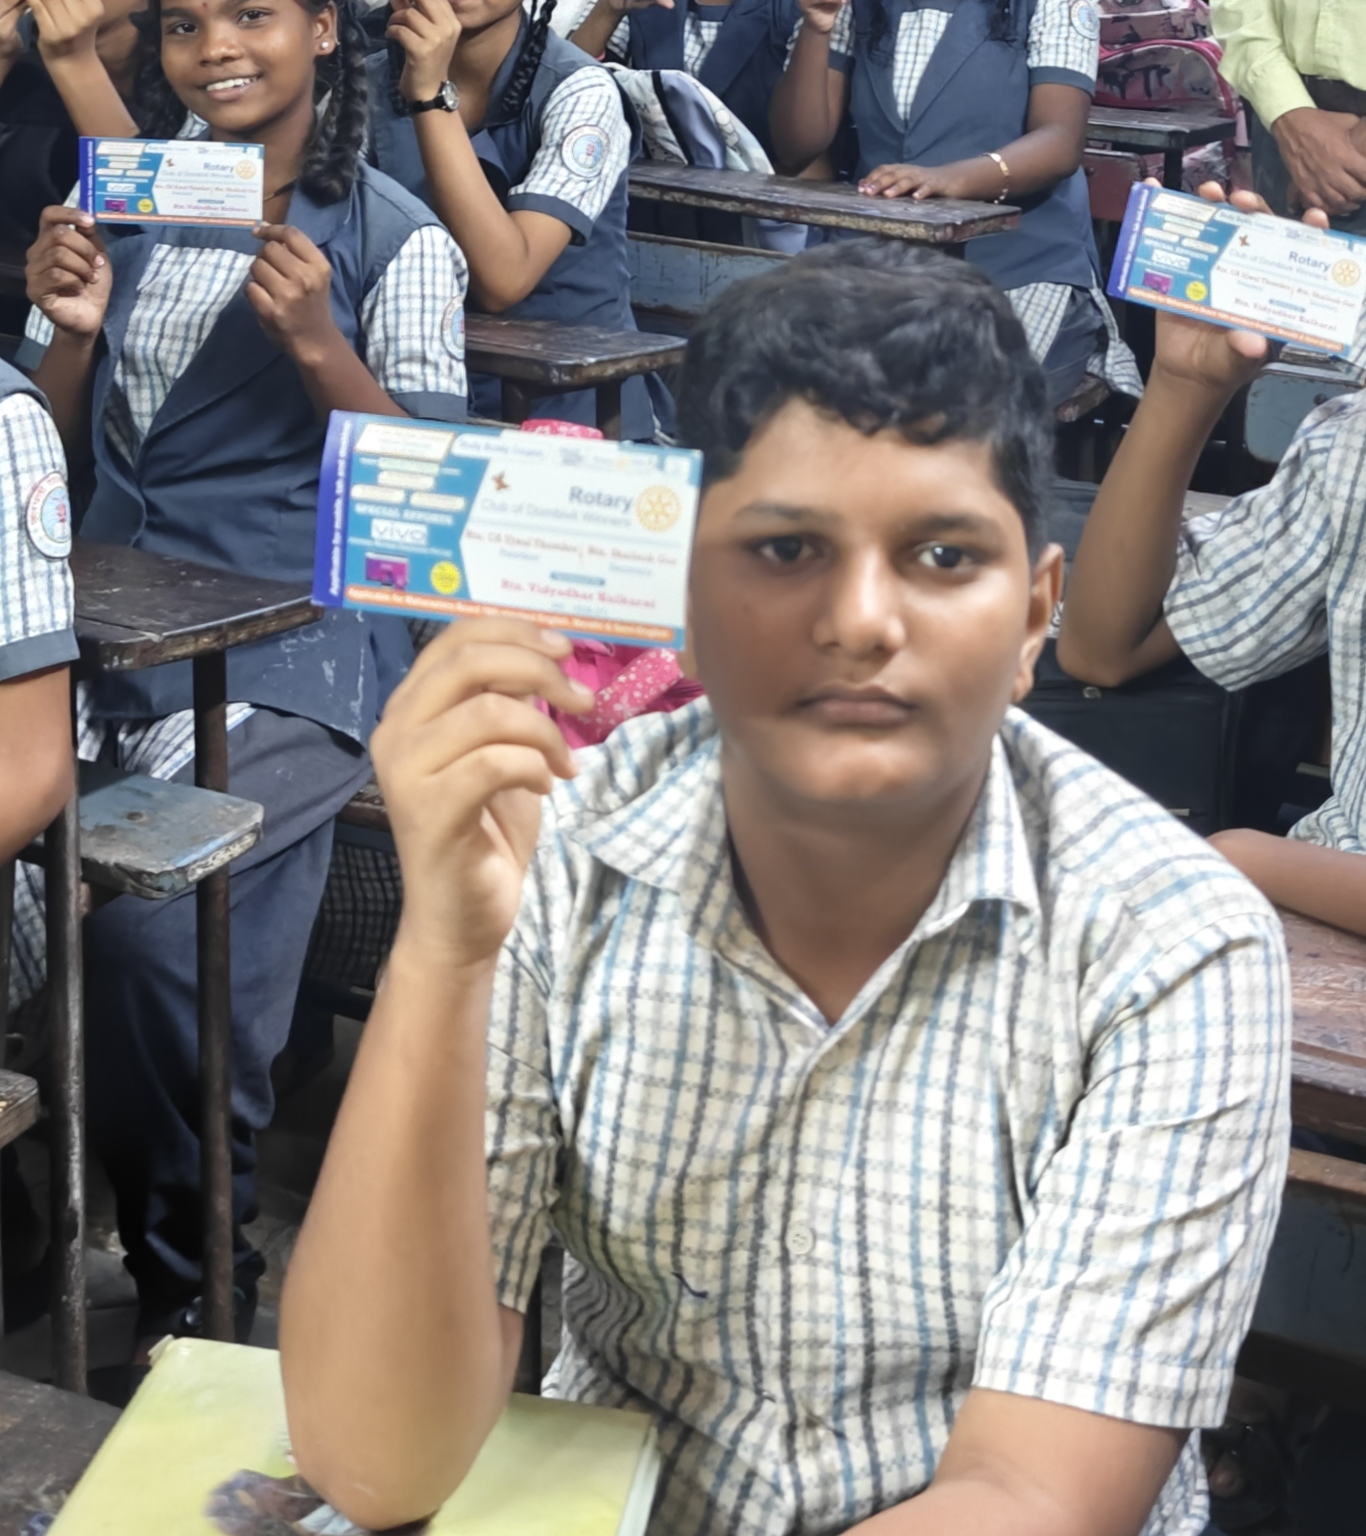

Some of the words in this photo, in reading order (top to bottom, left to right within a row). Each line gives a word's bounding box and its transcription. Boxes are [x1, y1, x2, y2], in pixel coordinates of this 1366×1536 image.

[1288, 249, 1331, 270] Rotary
[482, 498, 513, 515] Club
[515, 501, 527, 516] of
[569, 484, 633, 512] Rotary
[375, 519, 426, 543] vivo
[529, 582, 595, 606] Vidyadhar
